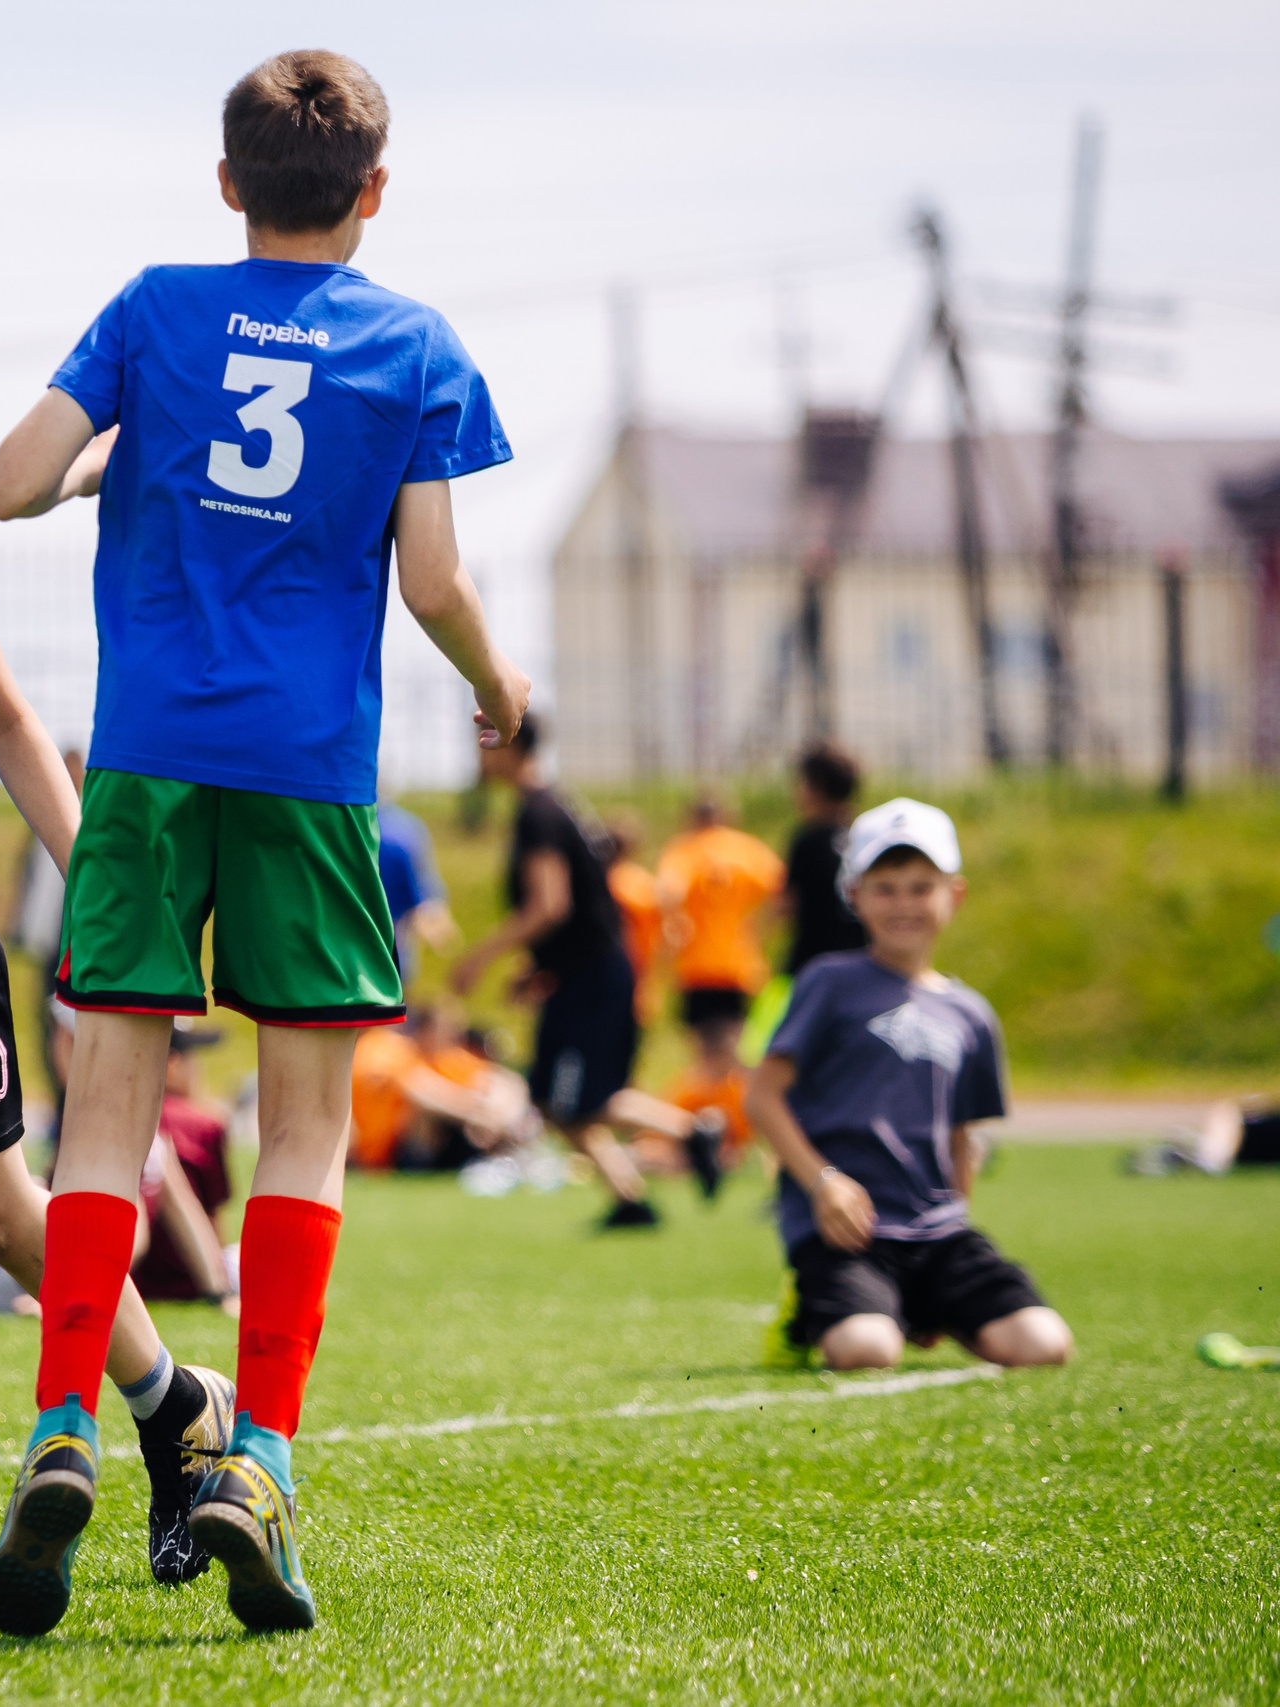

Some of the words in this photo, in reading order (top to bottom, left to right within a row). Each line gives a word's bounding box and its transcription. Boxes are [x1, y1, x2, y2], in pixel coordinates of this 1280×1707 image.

[226, 312, 330, 347] Первые
[206, 352, 314, 499] 3
[199, 498, 292, 523] METROSHKA.RU
